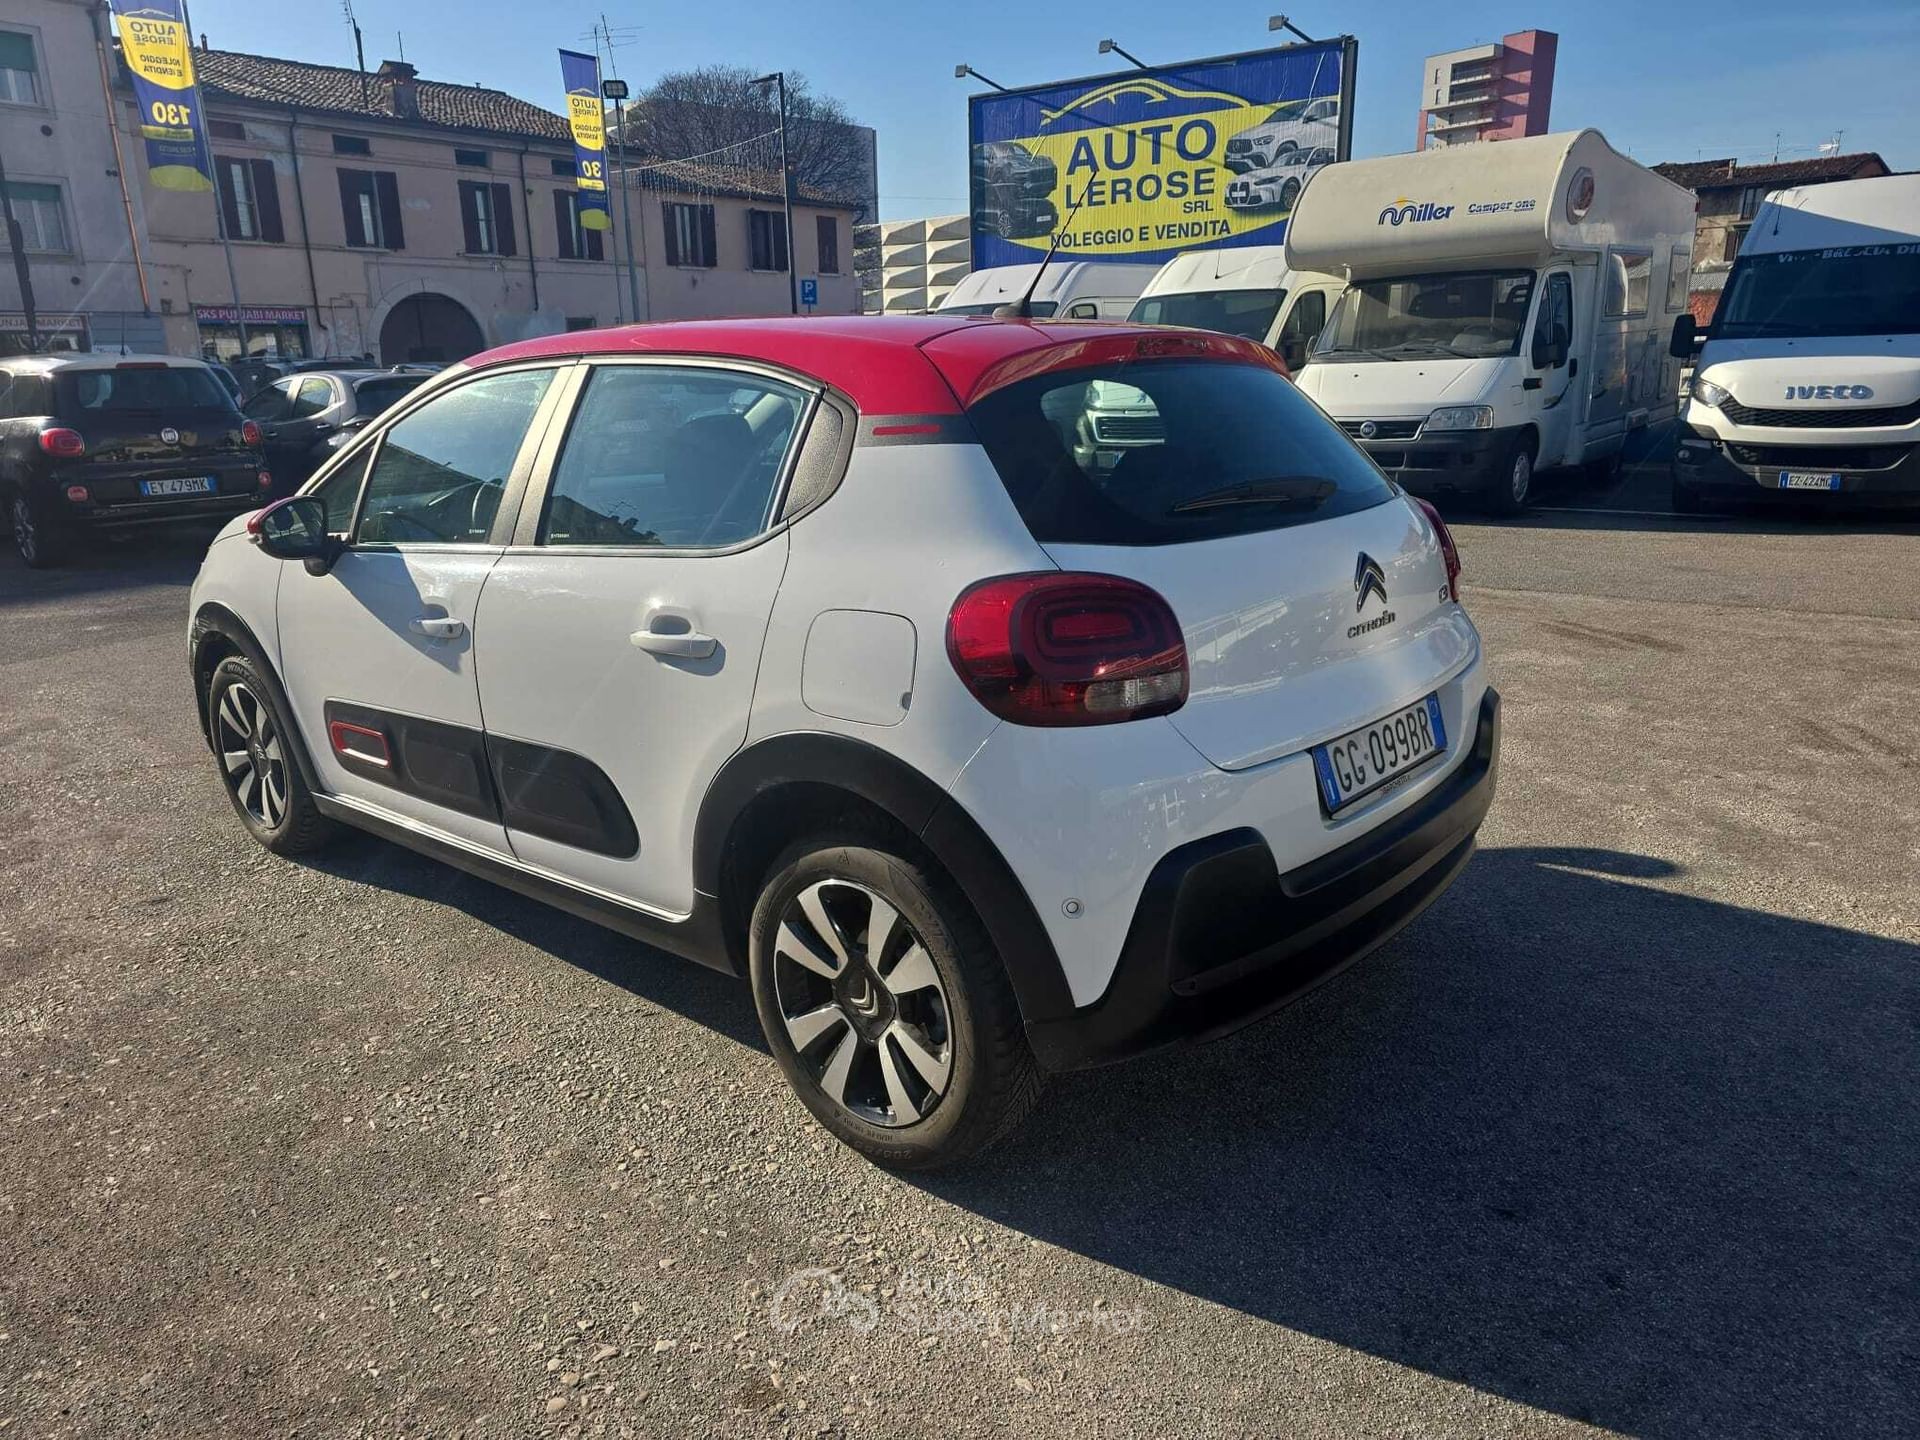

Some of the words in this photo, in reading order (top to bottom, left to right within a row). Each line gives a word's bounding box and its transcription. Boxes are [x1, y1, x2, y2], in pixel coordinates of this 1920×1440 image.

[1066, 118, 1217, 176] AUTO
[1065, 168, 1215, 209] LEROSE
[1183, 200, 1214, 214] SRL
[1468, 201, 1513, 214] Camper
[1050, 230, 1134, 249] NOLEGGIO
[1139, 226, 1149, 241] E
[1155, 219, 1231, 241] VENDITA
[804, 281, 814, 293] P
[197, 309, 217, 319] SKS
[265, 310, 305, 320] MARKET
[1784, 384, 1874, 400] IVECO
